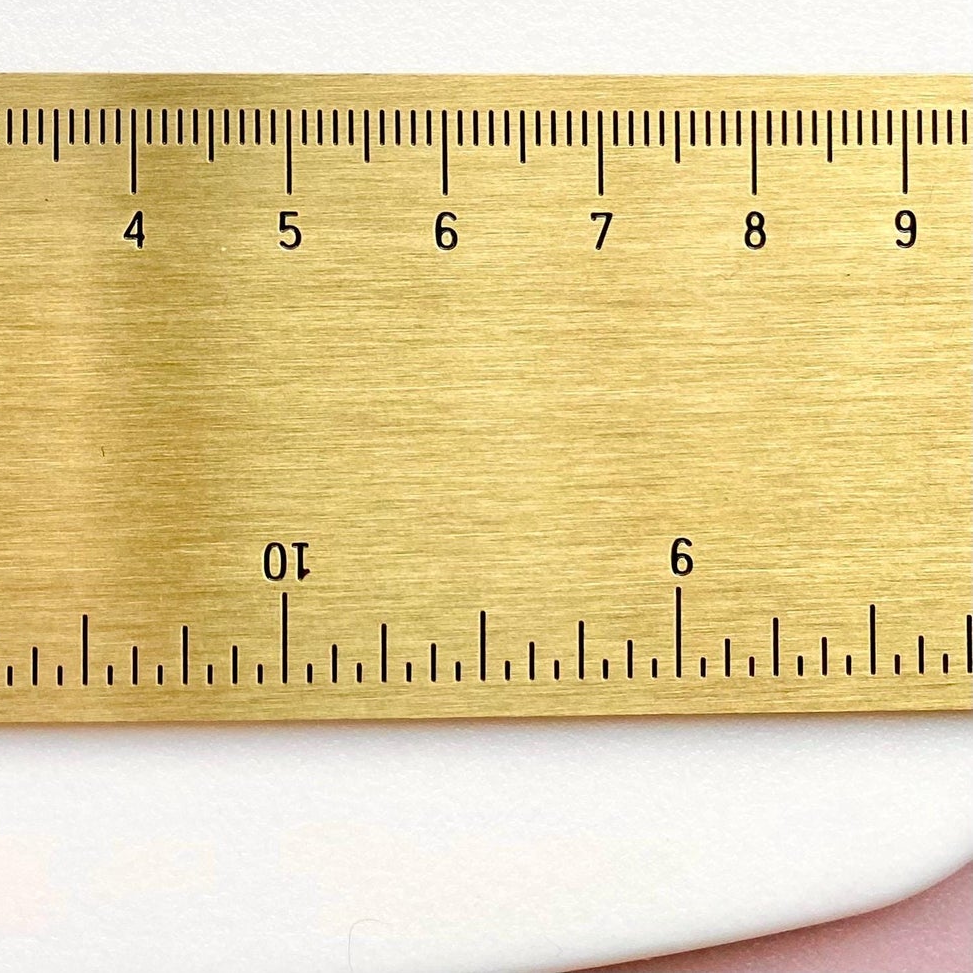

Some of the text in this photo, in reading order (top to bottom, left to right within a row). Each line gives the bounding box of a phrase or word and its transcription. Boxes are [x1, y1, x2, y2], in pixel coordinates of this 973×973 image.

[123, 210, 146, 249] 4
[279, 211, 302, 250] 5
[435, 211, 458, 251] 6
[590, 212, 613, 251] 7
[744, 210, 767, 250] 8
[894, 209, 917, 249] 9
[263, 541, 311, 582] 10
[670, 537, 694, 577] 9
